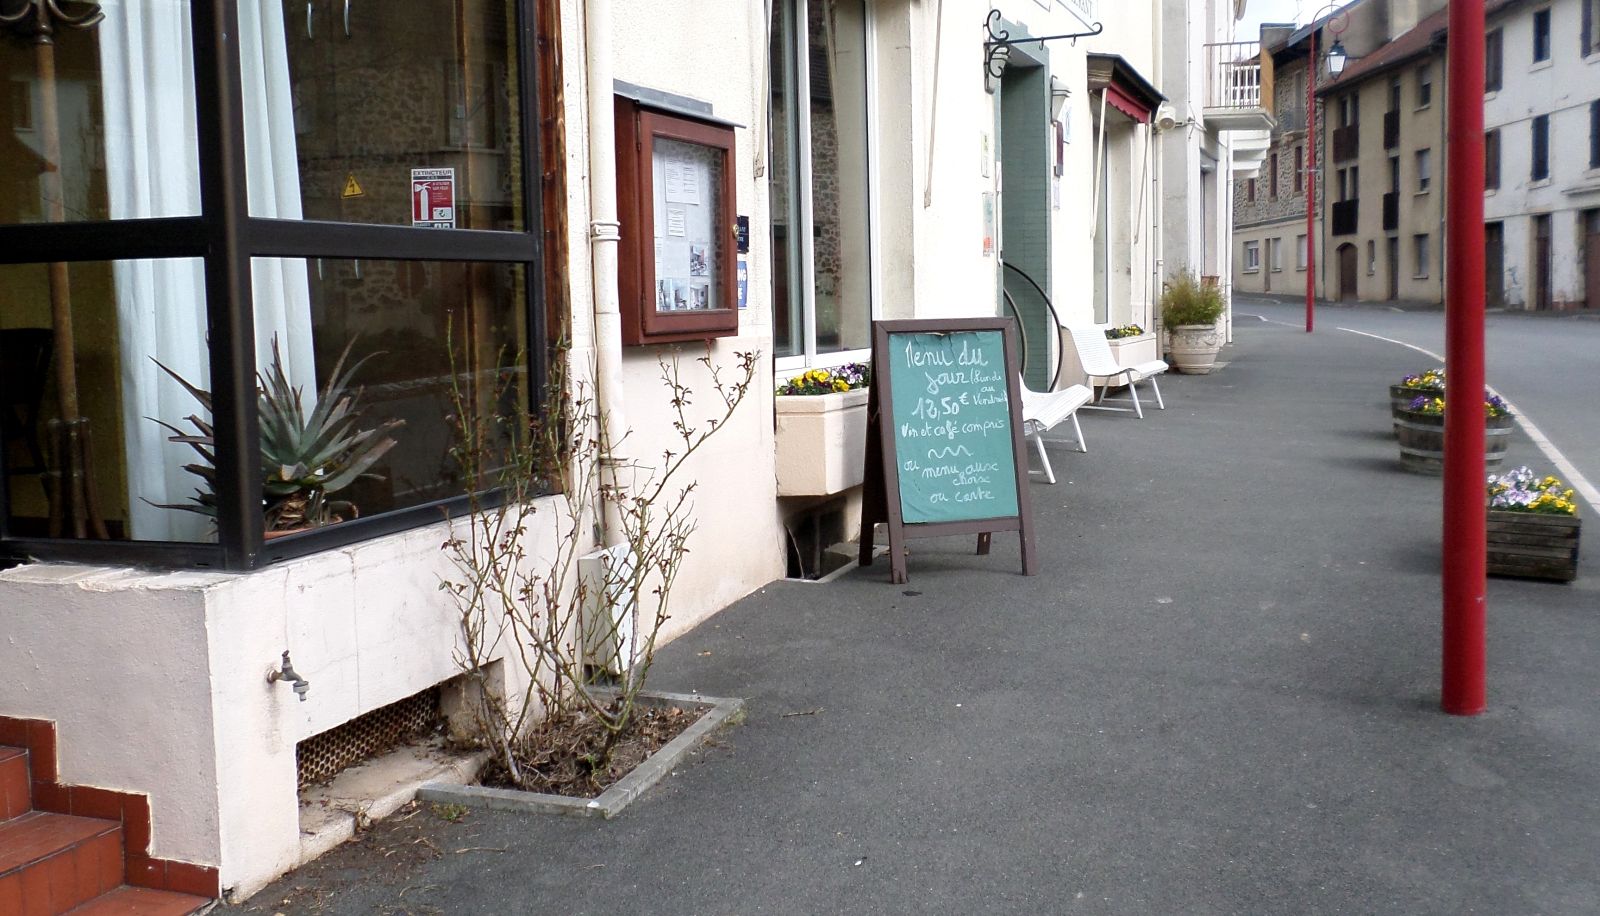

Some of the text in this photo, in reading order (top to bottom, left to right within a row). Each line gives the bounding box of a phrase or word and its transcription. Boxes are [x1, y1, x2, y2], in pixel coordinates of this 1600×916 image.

[905, 340, 989, 368] Menu du
[920, 418, 932, 437] et
[934, 420, 960, 440] café
[962, 418, 1006, 437] compris
[904, 460, 920, 471] ou
[922, 464, 960, 479] menu
[930, 487, 996, 504] ou carte
